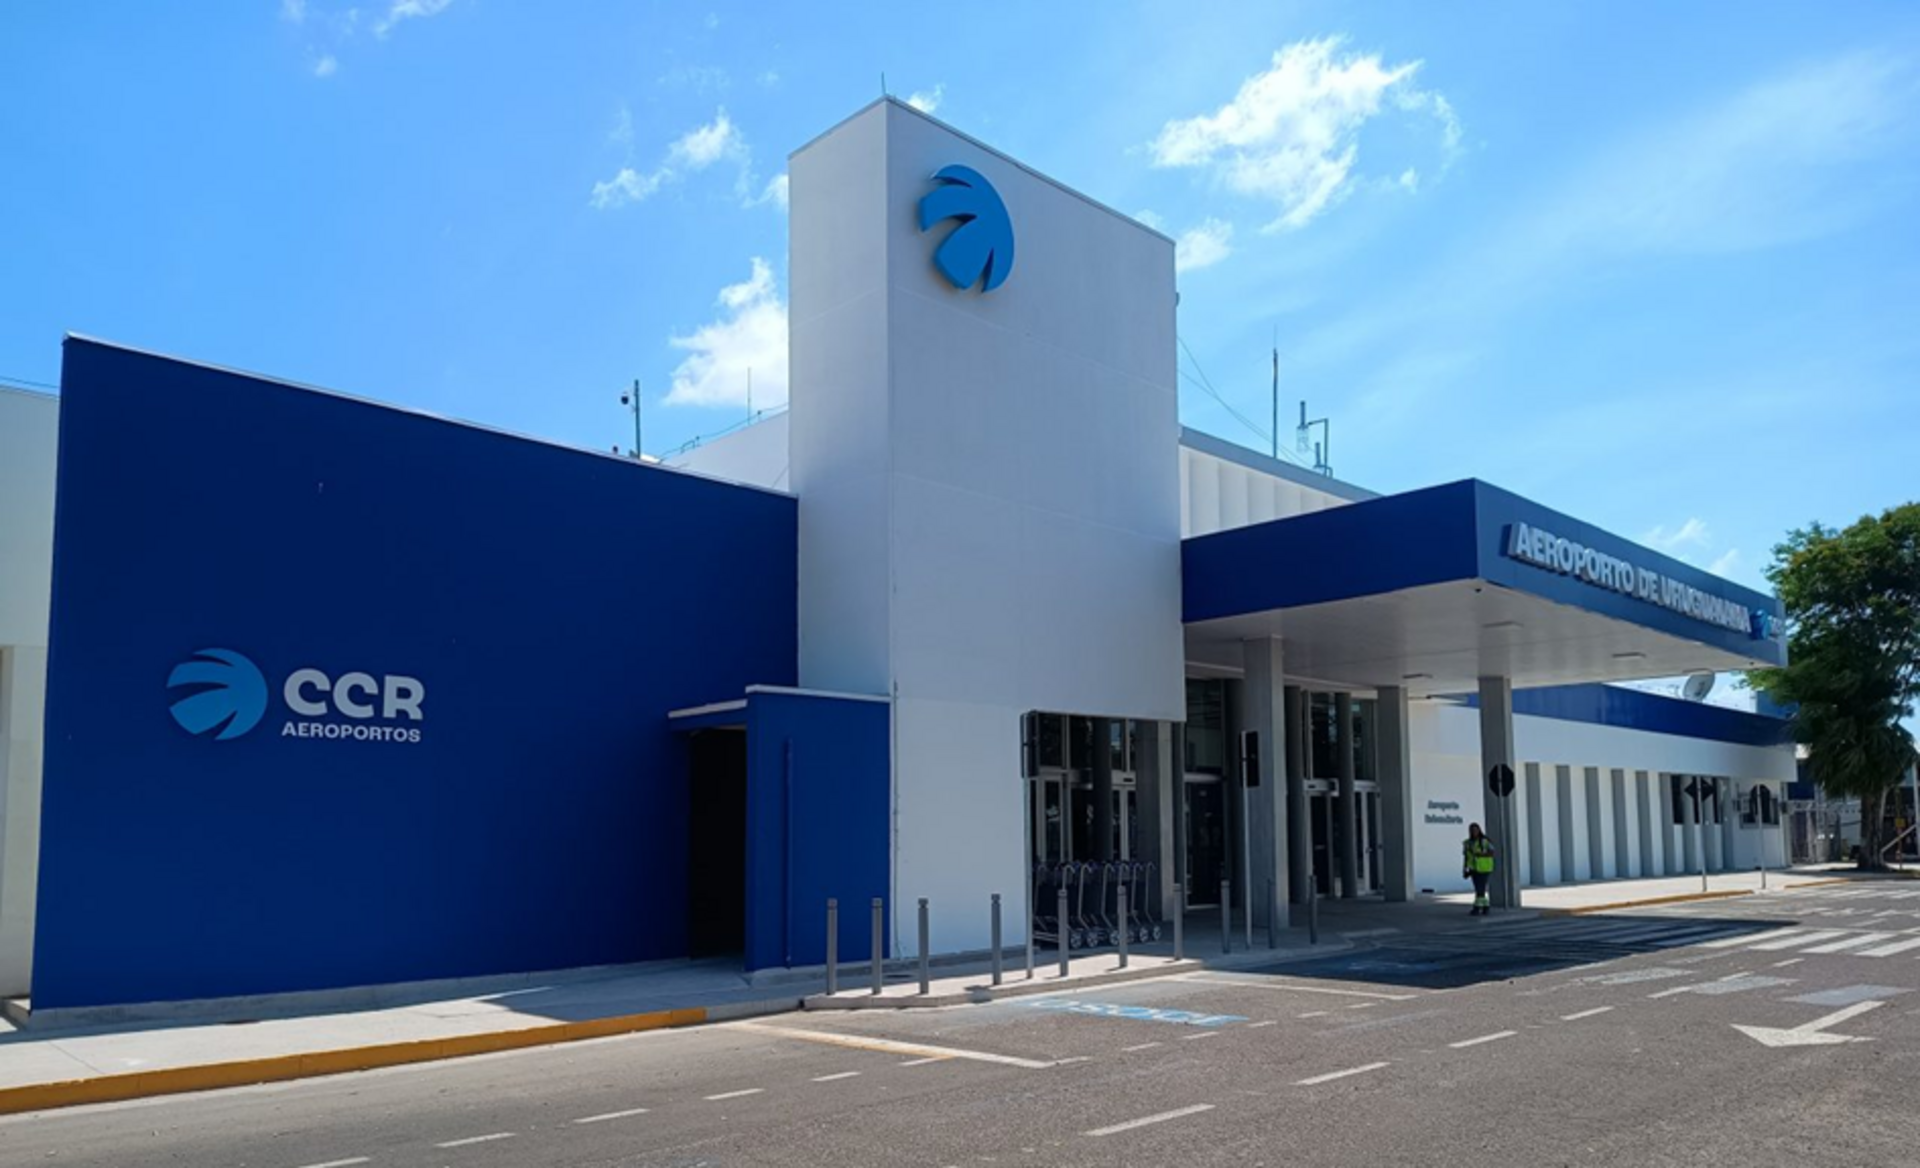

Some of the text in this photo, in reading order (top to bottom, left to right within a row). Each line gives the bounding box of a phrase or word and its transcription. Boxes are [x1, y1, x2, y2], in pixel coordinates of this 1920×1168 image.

[1513, 522, 1634, 593] AEROPORTO
[1638, 566, 1658, 600] DE
[284, 668, 425, 720] CCR
[281, 721, 421, 743] AEROPORTOS
